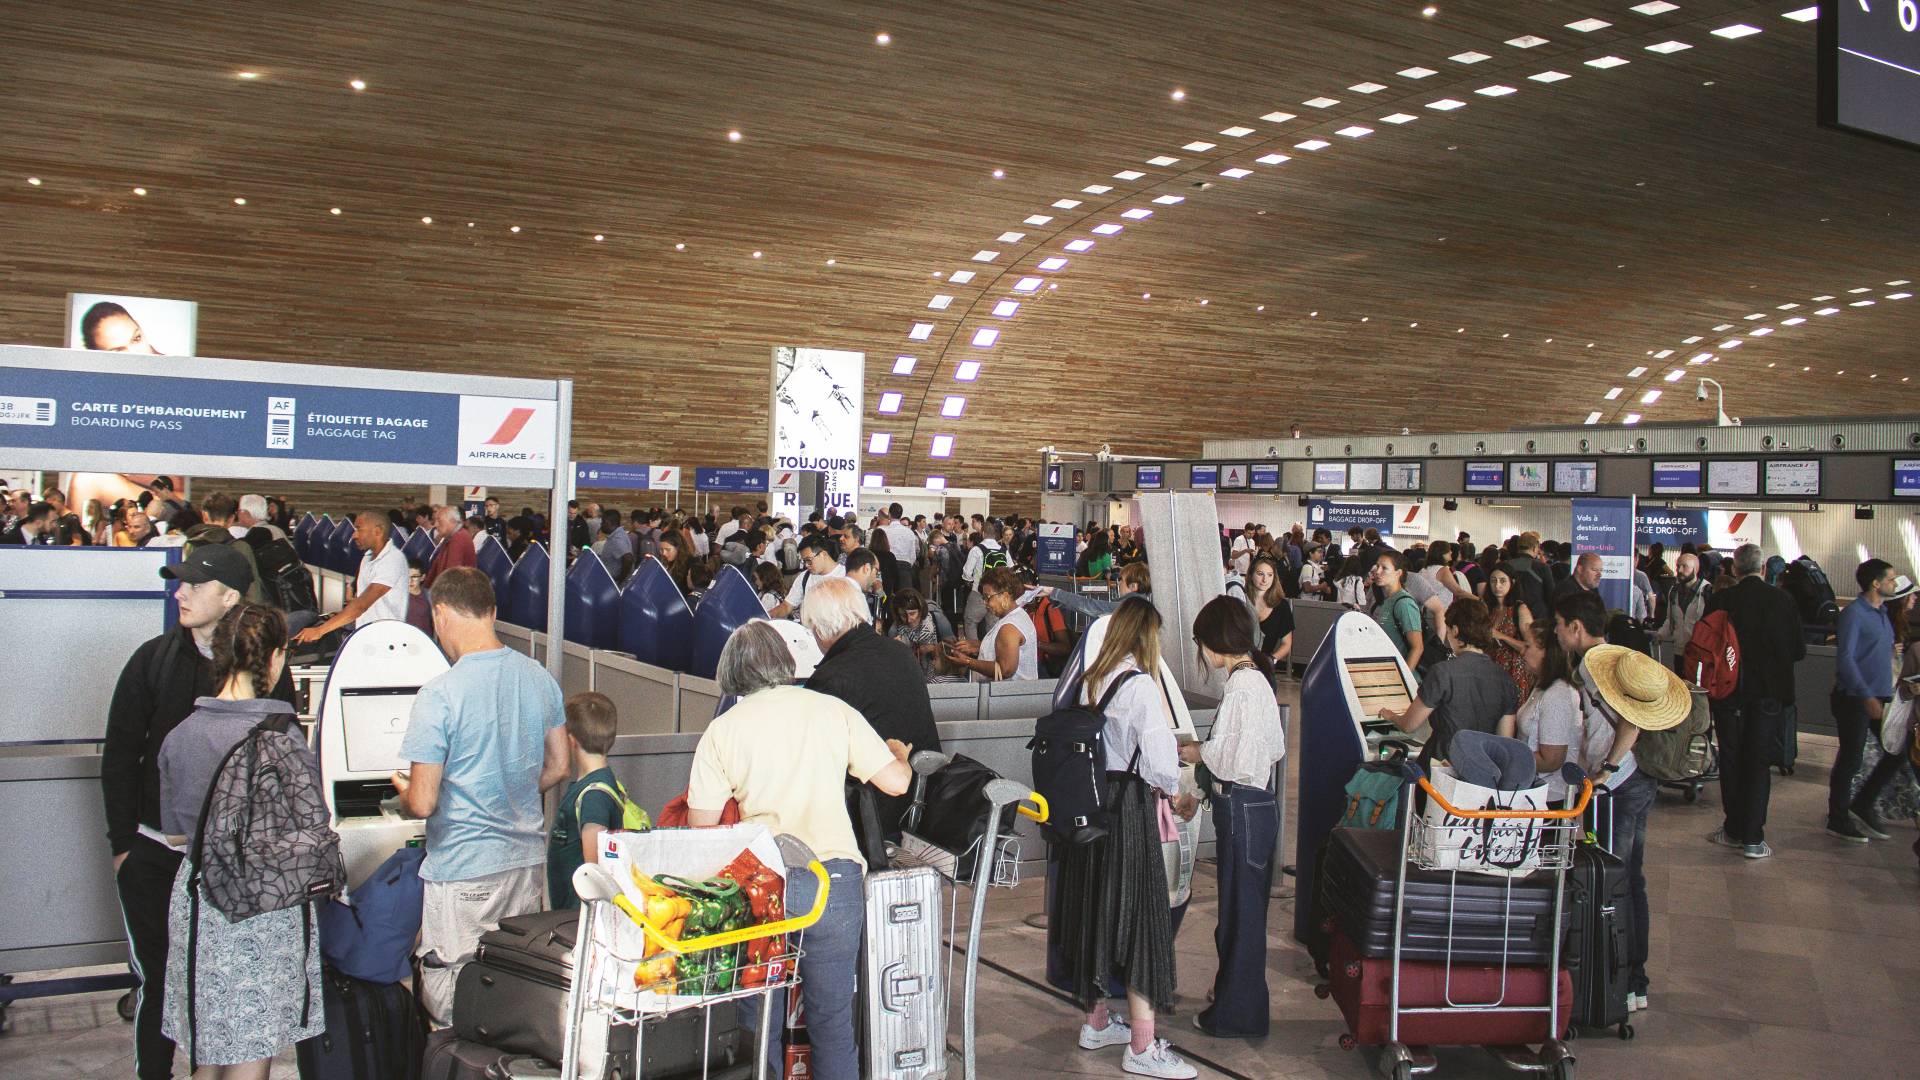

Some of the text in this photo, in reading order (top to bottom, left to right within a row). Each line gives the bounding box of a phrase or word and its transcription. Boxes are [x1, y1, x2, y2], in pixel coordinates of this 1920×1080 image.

[273, 401, 290, 410] AF
[71, 402, 247, 420] CARTE D'EMBARQUEMENT
[71, 416, 183, 430] BOARDING PASS
[307, 412, 429, 428] ÉTIQUETTE BAGAGE
[307, 427, 397, 440] BAGGAGE TAG
[271, 437, 289, 446] JFK
[468, 451, 527, 460] AIRFRANCE
[778, 456, 855, 471] TOUJOURS
[1328, 507, 1380, 516] DÉPOSE BAGAGES
[1328, 515, 1357, 523] BAGGAGE
[1576, 514, 1599, 522] Vols à
[1646, 516, 1688, 525] BAGAGES
[1655, 527, 1698, 536] DROP-OFF
